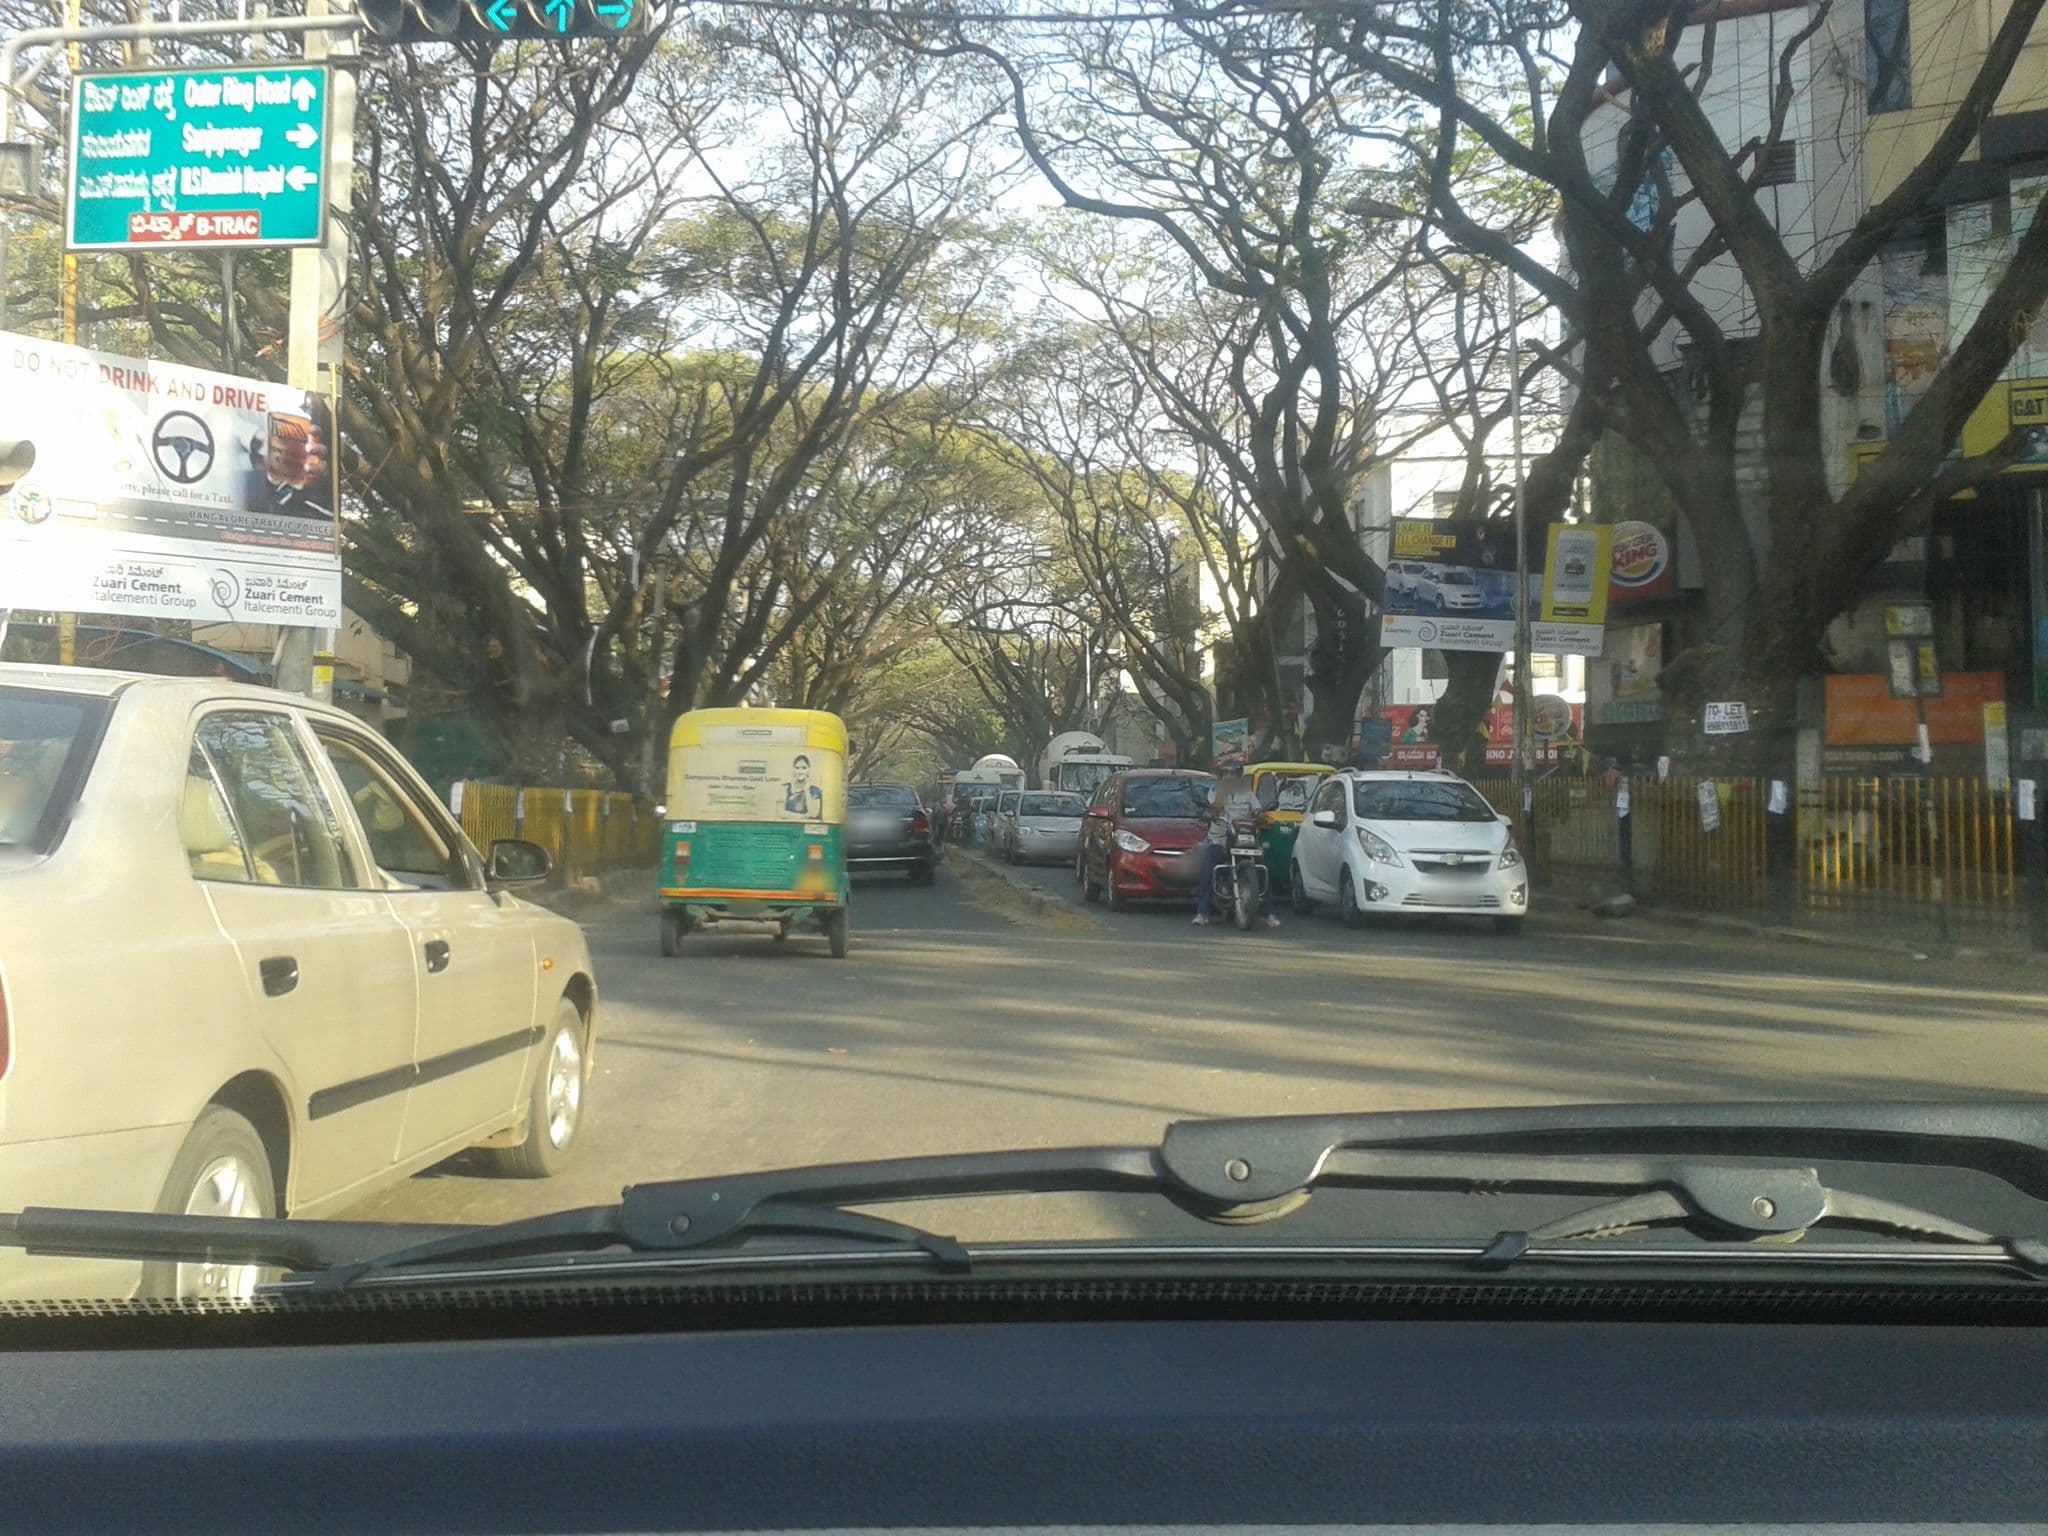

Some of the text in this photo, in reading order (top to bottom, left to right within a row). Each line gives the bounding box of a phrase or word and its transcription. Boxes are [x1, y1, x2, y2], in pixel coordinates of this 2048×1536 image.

[184, 74, 291, 112] Outer Ring Road
[196, 215, 257, 236] B-TRAC
[13, 349, 266, 412] DO NOT DRINK AND DRIVE
[189, 511, 330, 535] BANGALORE TRAFFIC POLICE
[93, 576, 182, 594] Zuari Cement
[161, 594, 196, 609] Group
[245, 588, 323, 605] Zuari Cement
[244, 601, 336, 618] Italcementi Group
[1463, 631, 1494, 639] Cement
[1724, 703, 1743, 715] LET
